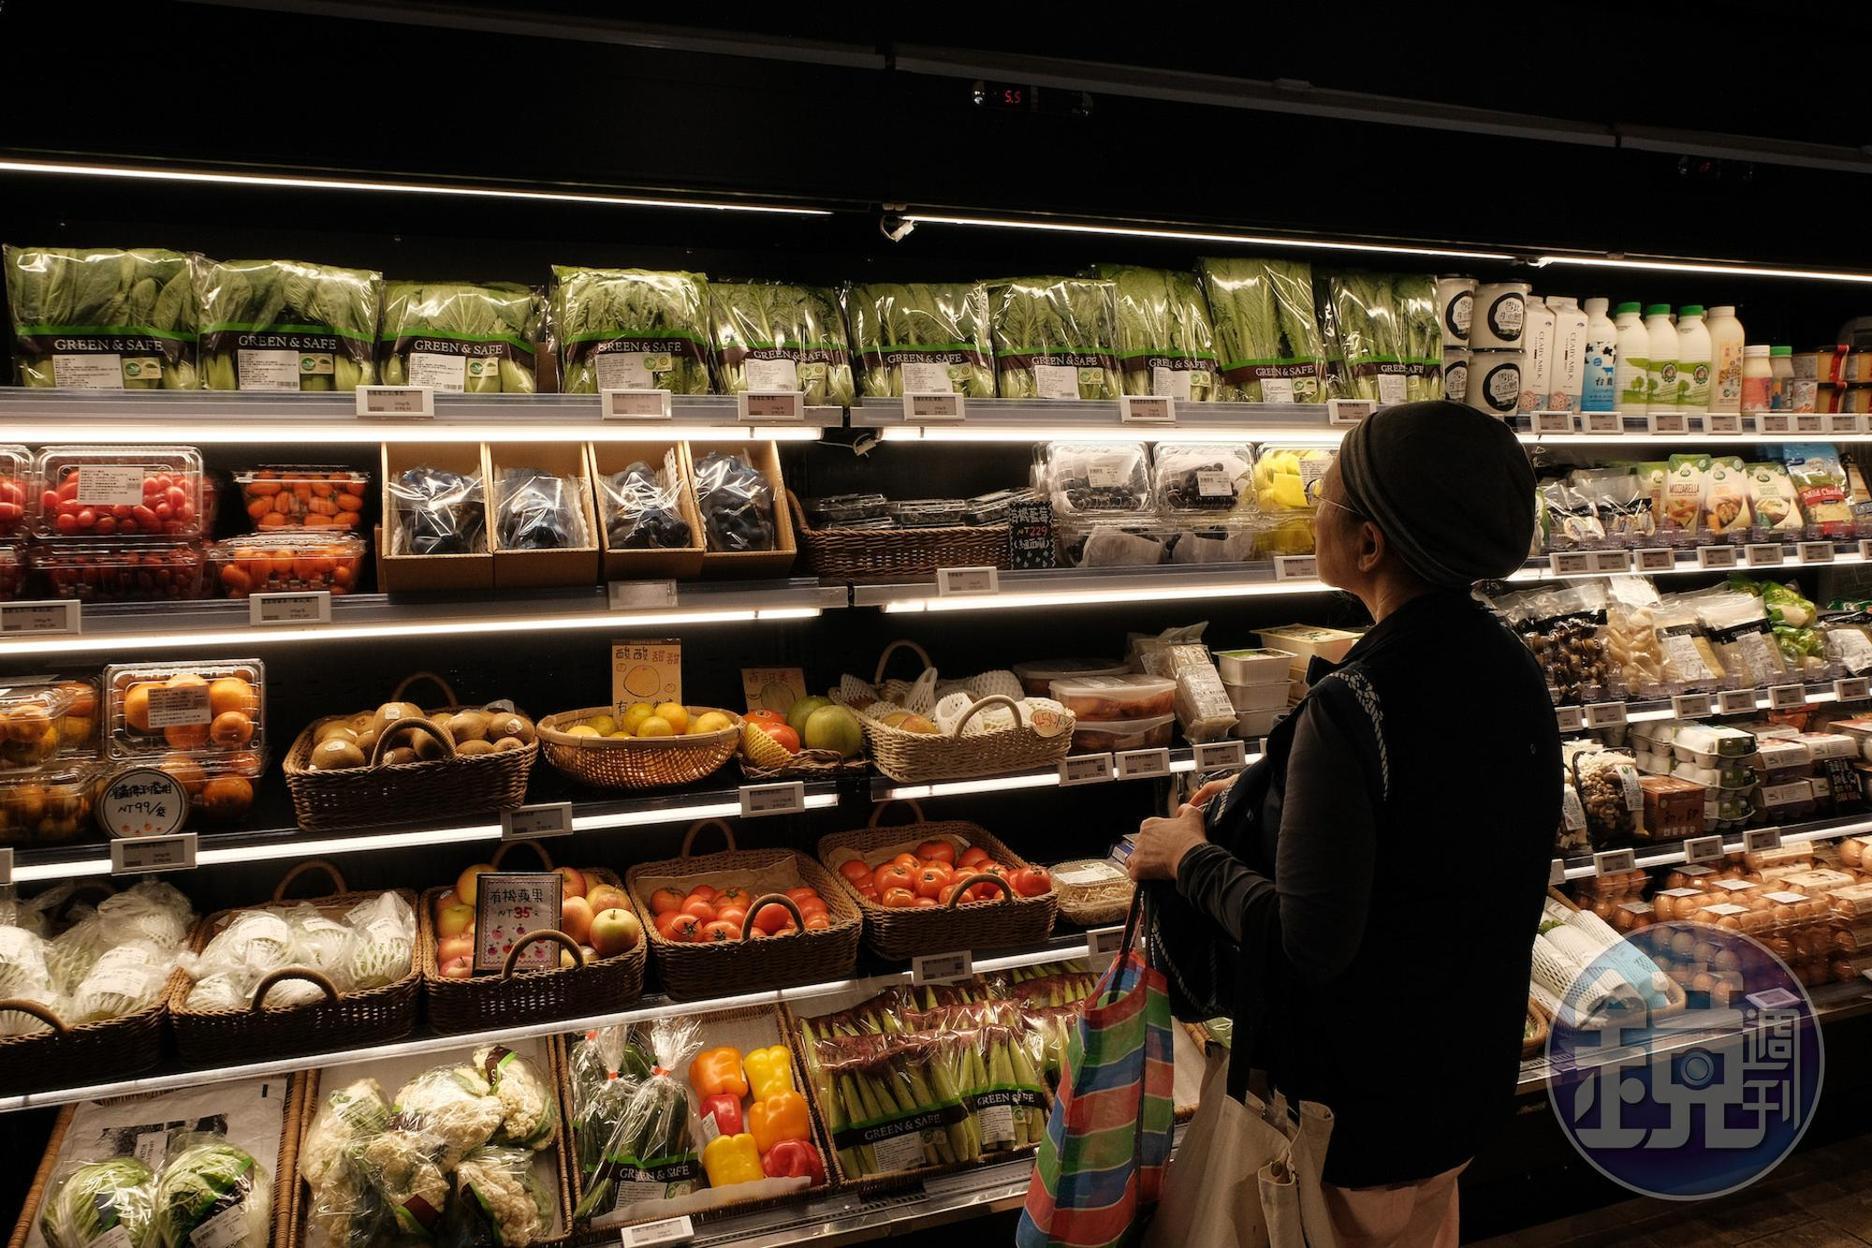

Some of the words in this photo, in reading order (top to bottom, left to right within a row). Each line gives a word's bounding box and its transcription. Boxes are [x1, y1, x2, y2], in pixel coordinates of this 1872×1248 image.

[54, 339, 109, 350] GREEN
[112, 339, 124, 350] &
[126, 340, 163, 351] SAFE
[239, 335, 287, 347] GREEN
[290, 338, 300, 348] &
[303, 338, 337, 350] SAFE
[414, 340, 460, 353] GREEN
[461, 345, 472, 354] &
[474, 344, 503, 355] SAFE
[642, 342, 652, 352] &
[652, 341, 682, 352] SAFE
[753, 350, 792, 359] GREEN
[792, 351, 801, 362] &
[887, 353, 924, 363] GREEN
[925, 354, 934, 364] &
[936, 353, 962, 362] SAFE
[1066, 355, 1073, 365] &
[1074, 356, 1098, 366] SAFE
[1174, 359, 1183, 369] &
[1256, 367, 1282, 377] GREEN
[1282, 367, 1289, 377] &
[1289, 365, 1314, 376] SAFE
[864, 1122, 904, 1140] GREEN
[905, 1119, 914, 1131] &
[914, 1113, 941, 1129] SAFE
[656, 1168, 666, 1180] &
